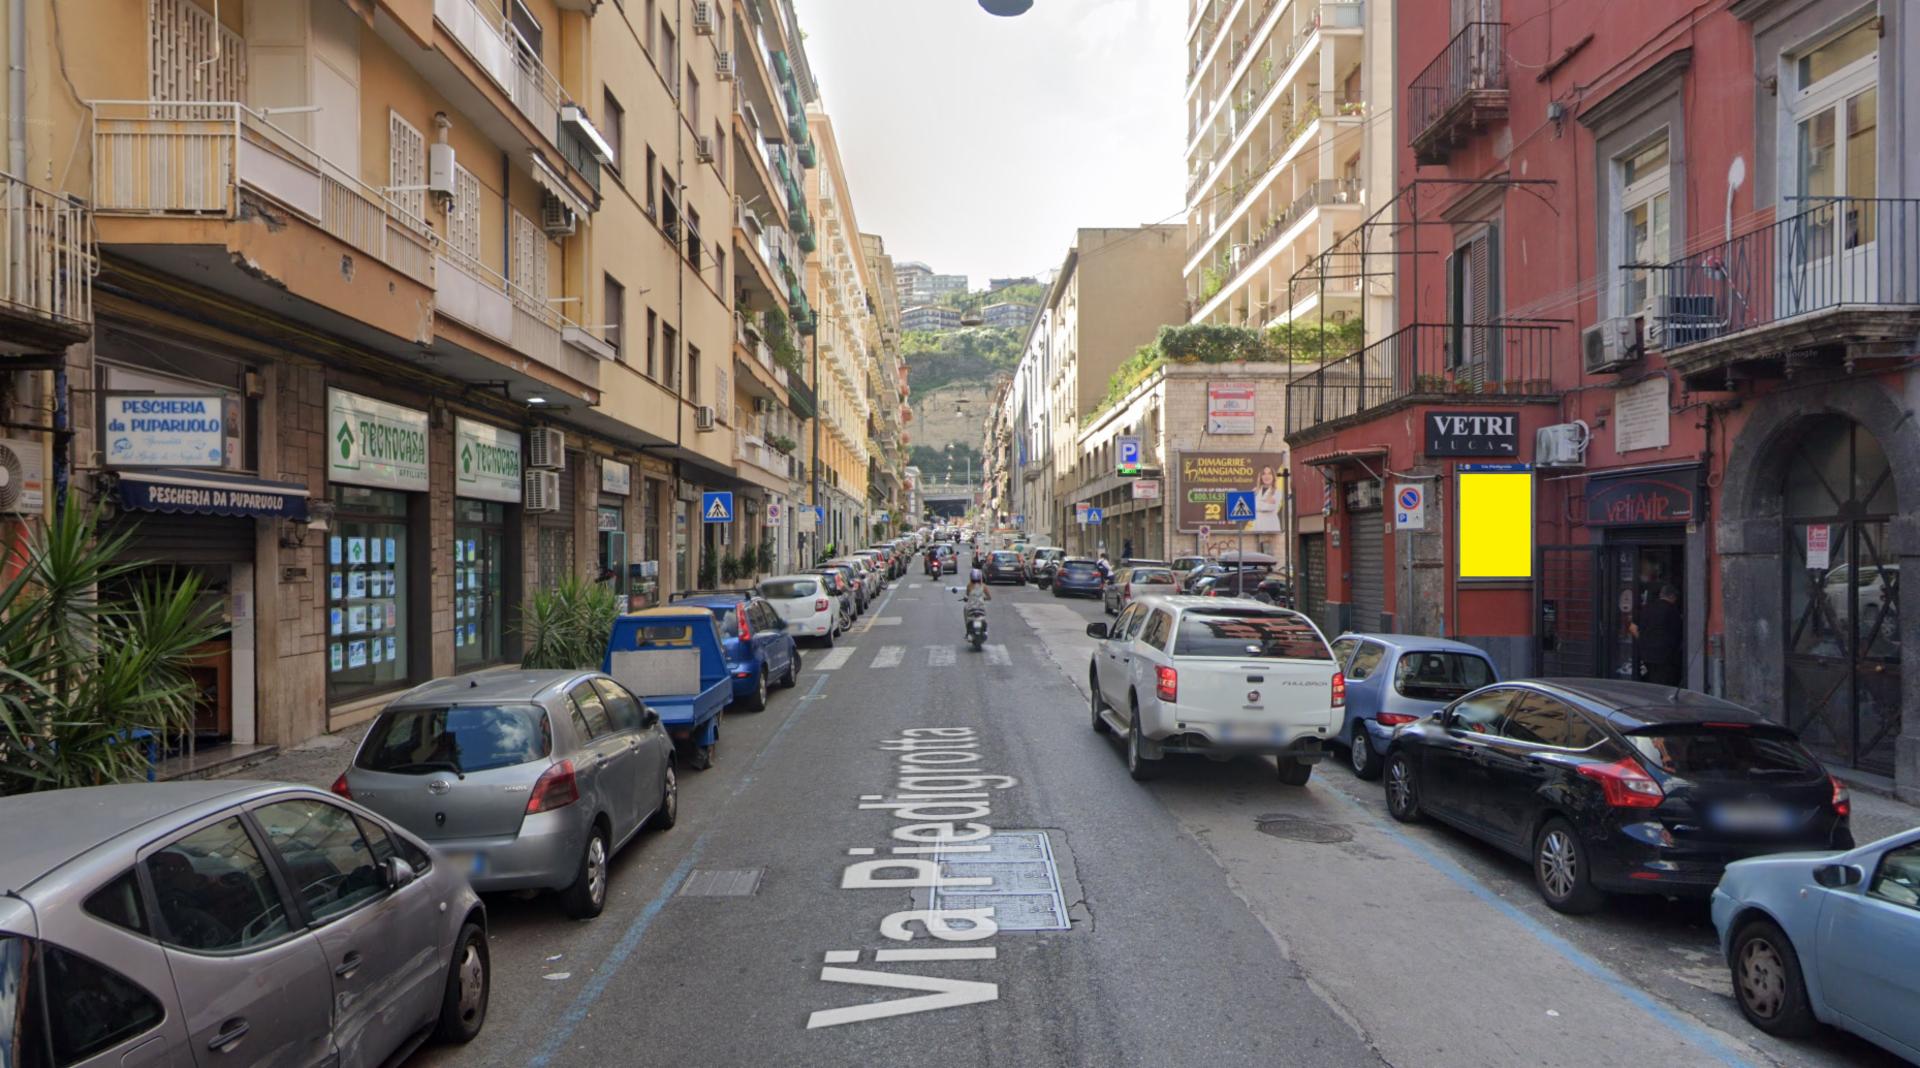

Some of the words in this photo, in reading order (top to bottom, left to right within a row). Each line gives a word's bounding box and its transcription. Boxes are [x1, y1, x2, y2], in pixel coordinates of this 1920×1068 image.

[121, 400, 206, 414] PESCHERIA
[108, 418, 126, 432] da
[131, 419, 220, 432] PUPARUOLO
[1433, 416, 1514, 436] VETRI
[359, 421, 426, 465] TECNOCASA
[1434, 440, 1494, 450] LUCA
[1122, 443, 1136, 462] P
[475, 442, 519, 478] TECNOCASA
[1199, 458, 1245, 467] DIMAGRIRE
[399, 469, 427, 480] AFFILIATO
[1199, 467, 1253, 476] MANGIANDO
[149, 486, 211, 506] PESCHERIA
[213, 491, 227, 507] DA
[230, 492, 284, 510] PUPARUOLO
[1205, 504, 1220, 514] 20
